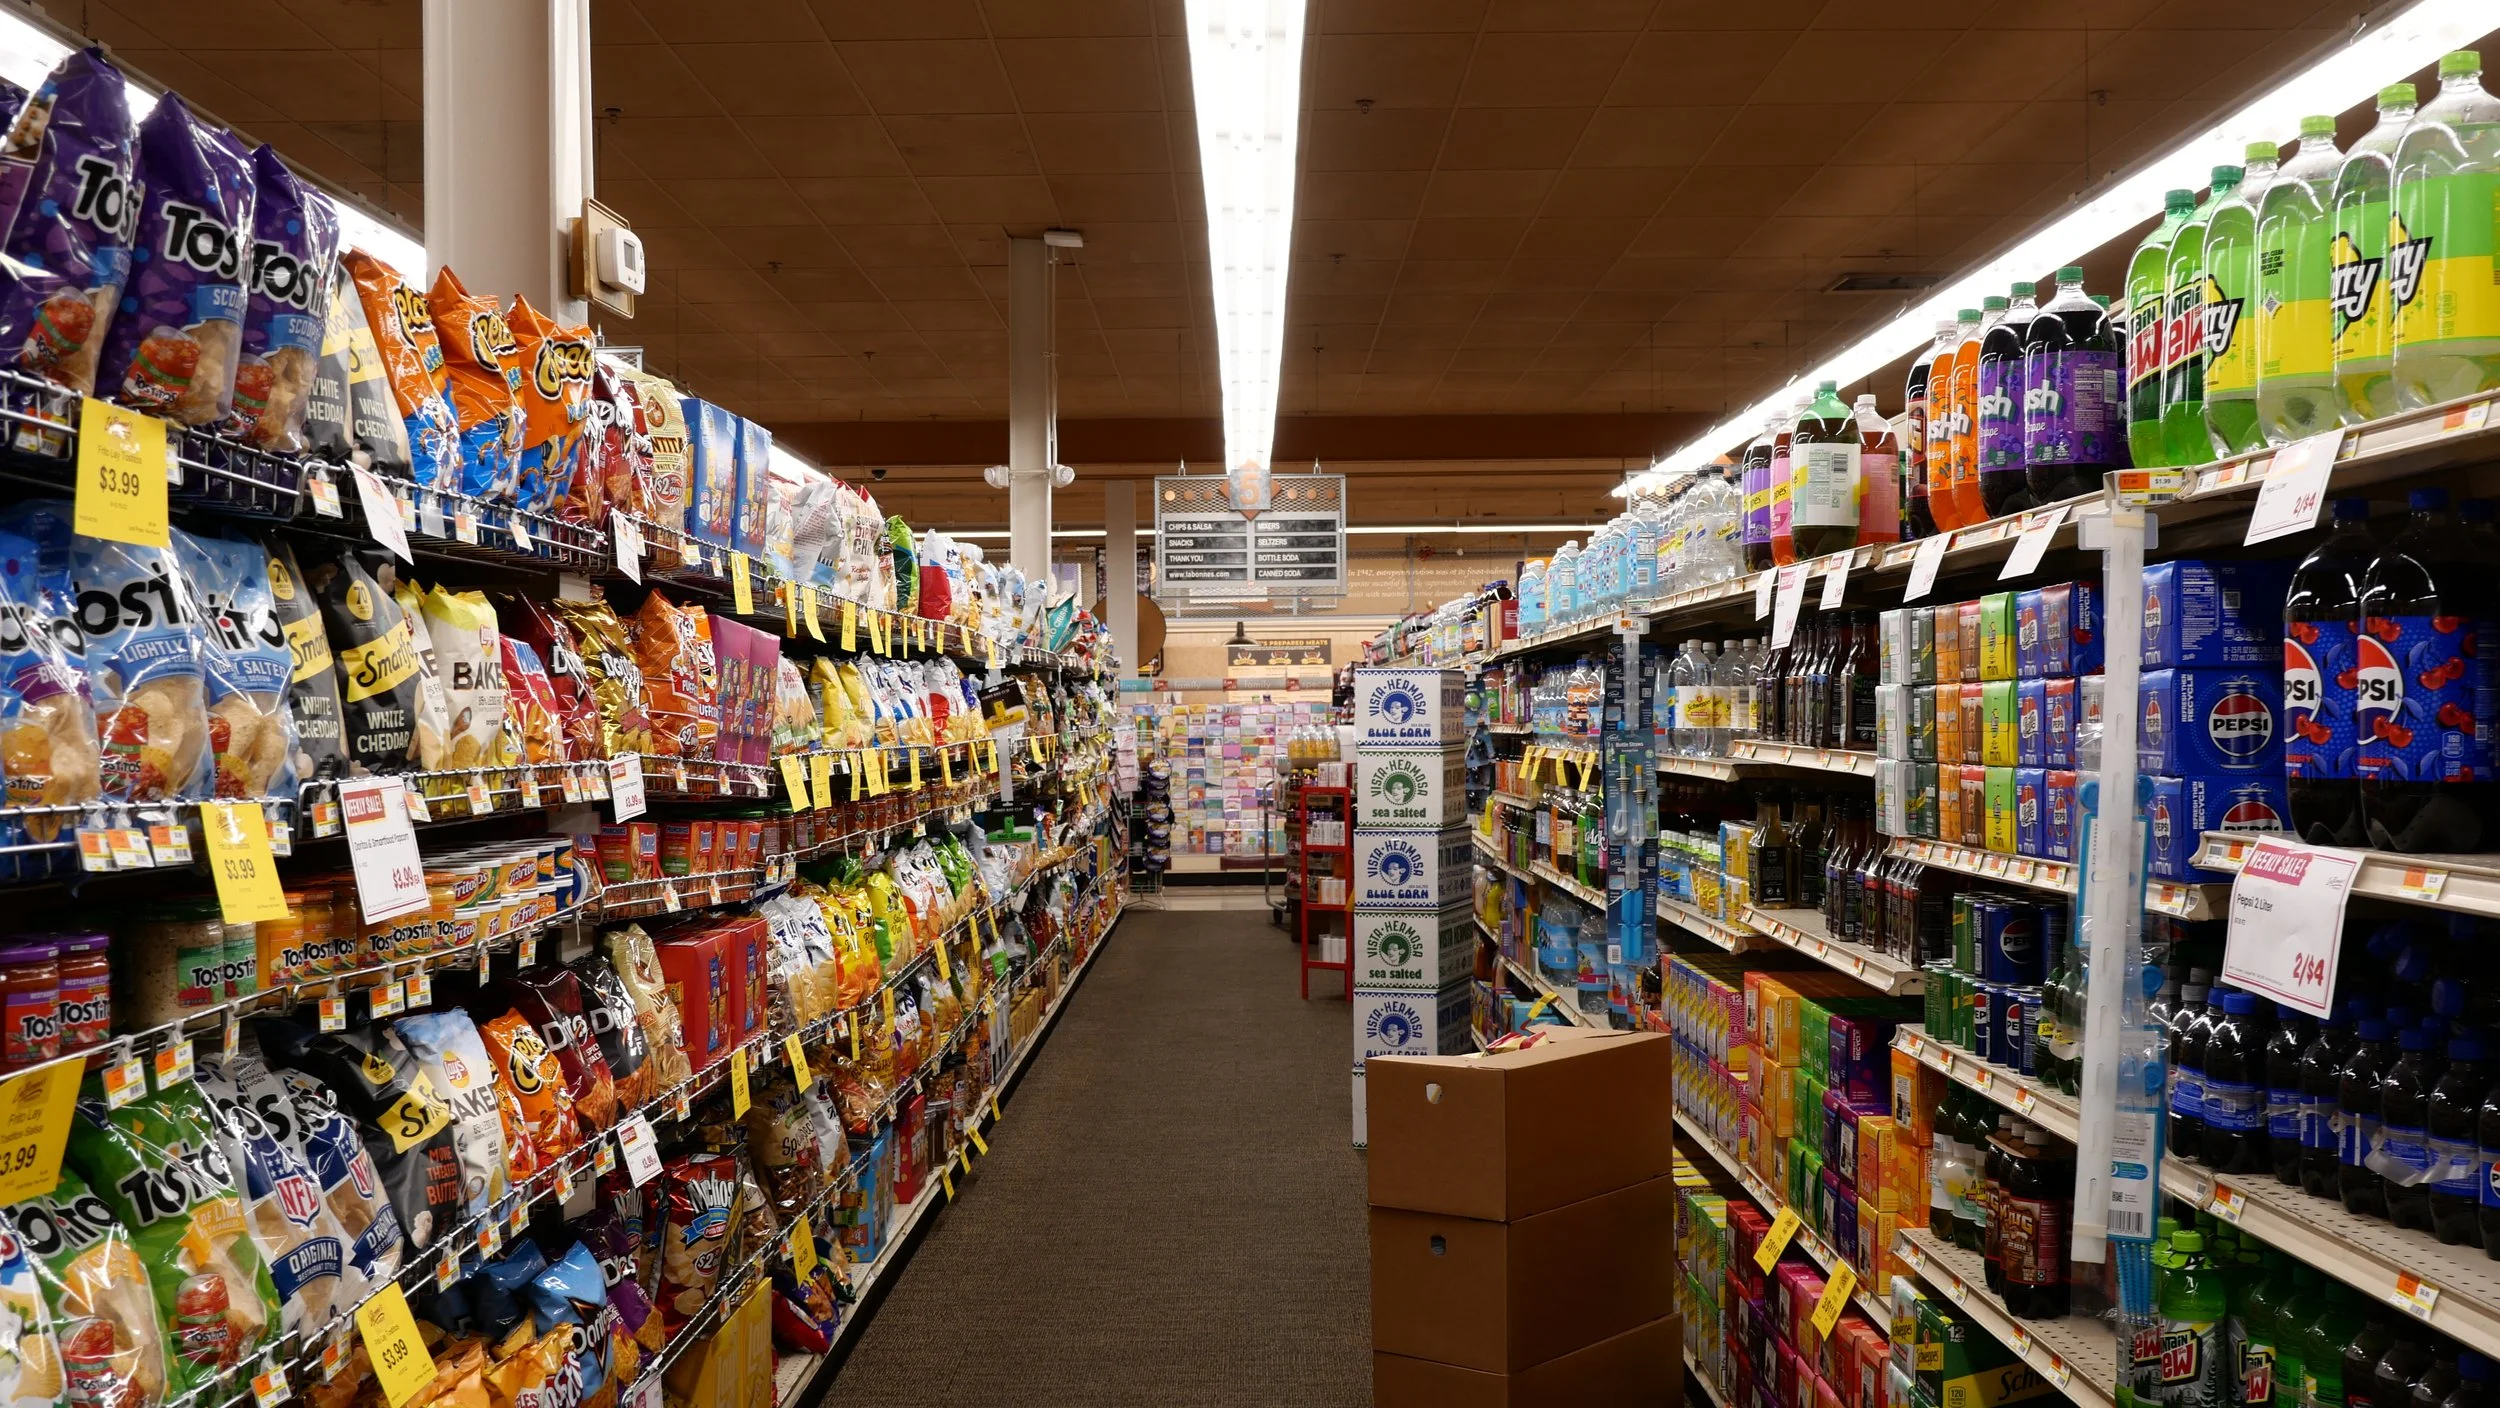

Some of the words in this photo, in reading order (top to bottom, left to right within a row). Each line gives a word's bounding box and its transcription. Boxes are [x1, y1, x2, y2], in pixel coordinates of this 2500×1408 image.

[135, 373, 178, 403] TOSTITOS
[99, 465, 140, 497] $3.99
[1240, 474, 1262, 504] 5
[2293, 493, 2316, 518] 2/$4
[1169, 523, 1186, 531] CHIPS
[1193, 523, 1212, 531] SALSA
[1257, 522, 1280, 530] MIXERS
[1169, 539, 1194, 547] SNACKS
[1257, 538, 1287, 546] SELTZERS
[1169, 554, 1189, 562] THANK
[1190, 554, 1203, 562] YOU
[1258, 554, 1281, 562] BOTTLE
[1282, 553, 1299, 562] SODA
[1169, 570, 1230, 579] www.labonnes.com
[1258, 569, 1283, 578] CANNED
[1284, 569, 1301, 577] SODA
[354, 585, 368, 607] 70
[243, 661, 288, 681] SALTED
[1369, 687, 1386, 717] VISTA
[1387, 678, 1427, 715] HERMOSA
[2359, 679, 2396, 701] PSI
[300, 696, 332, 720] WHITE
[296, 719, 339, 739] CHEDDAR
[366, 708, 405, 731] WHITE
[2212, 718, 2269, 732] PEPSI
[356, 731, 410, 753] CHEDDAR
[1368, 728, 1397, 737] BLUE
[1400, 728, 1431, 737] CORN
[1371, 767, 1388, 797] VISTA
[1388, 759, 1428, 796] HERMOSA
[346, 798, 366, 818] WEEKLY
[365, 794, 383, 815] SALE!
[1372, 809, 1390, 818] sea
[1393, 807, 1427, 818] salted
[2153, 822, 2169, 834] PEPSI
[224, 858, 256, 880] $3.99
[1367, 848, 1384, 878] VISTA
[1385, 840, 1424, 877] HERMOSA
[2249, 850, 2282, 873] WEEKLY
[2278, 856, 2305, 878] SALE!
[1367, 889, 1395, 899] BLUE
[1398, 889, 1429, 899] CORN
[2236, 893, 2254, 908] Pepsi
[2254, 897, 2260, 909] 2
[2259, 899, 2273, 912] Liter
[1367, 928, 1383, 958] VISTA
[1385, 920, 1424, 958] HERMOSA
[1369, 969, 1387, 979] sea
[1390, 968, 1422, 979] salted
[2293, 952, 2326, 987] 2/$4
[1731, 995, 1742, 1003] 12
[1366, 1010, 1383, 1039] VISTA
[1384, 1001, 1423, 1039] HERMOSA
[8, 1112, 26, 1127] Frito
[27, 1108, 42, 1122] Lay
[24, 1124, 44, 1138] Salsa
[277, 1176, 319, 1218] NFL
[1680, 1188, 1691, 1196] 12
[289, 1242, 338, 1274] ORIGINAL
[188, 1330, 229, 1343] TOSTITOS
[1948, 1325, 1965, 1338] 12
[382, 1338, 409, 1371] $3.99
[1950, 1389, 1964, 1398] 120
